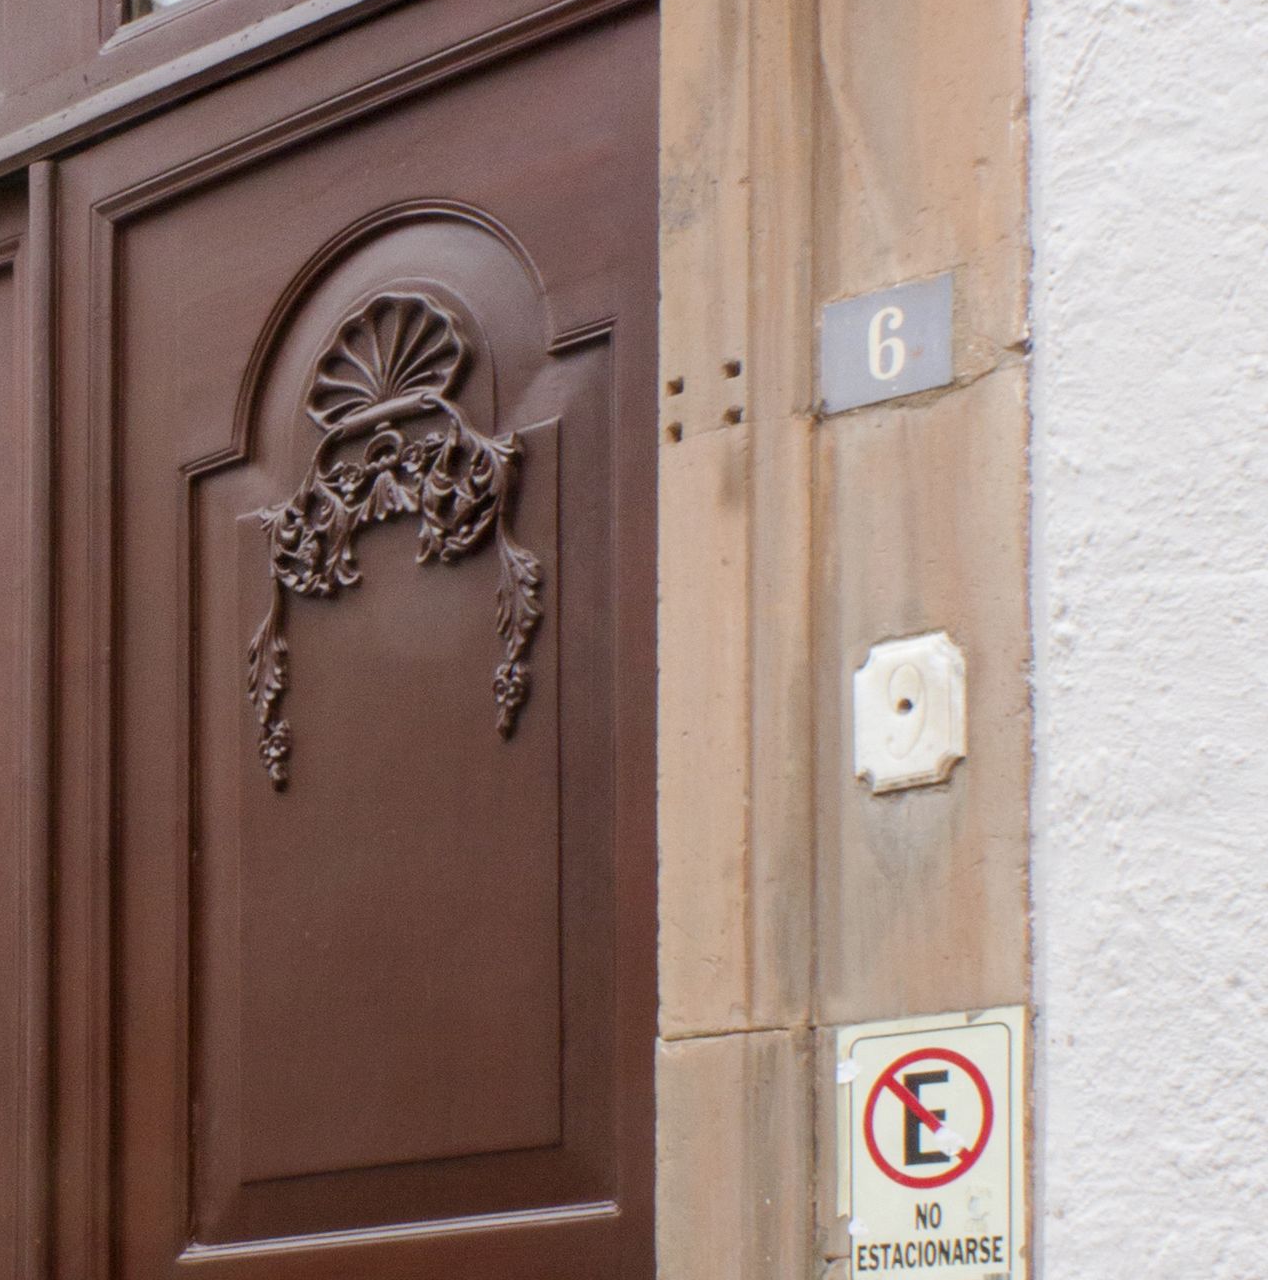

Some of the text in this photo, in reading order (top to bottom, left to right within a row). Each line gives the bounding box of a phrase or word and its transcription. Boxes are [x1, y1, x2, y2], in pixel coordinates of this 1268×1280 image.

[868, 306, 906, 380] 6
[903, 1069, 951, 1166] E
[915, 1202, 942, 1230] NO
[857, 1235, 1004, 1272] ESTACIONARSE
